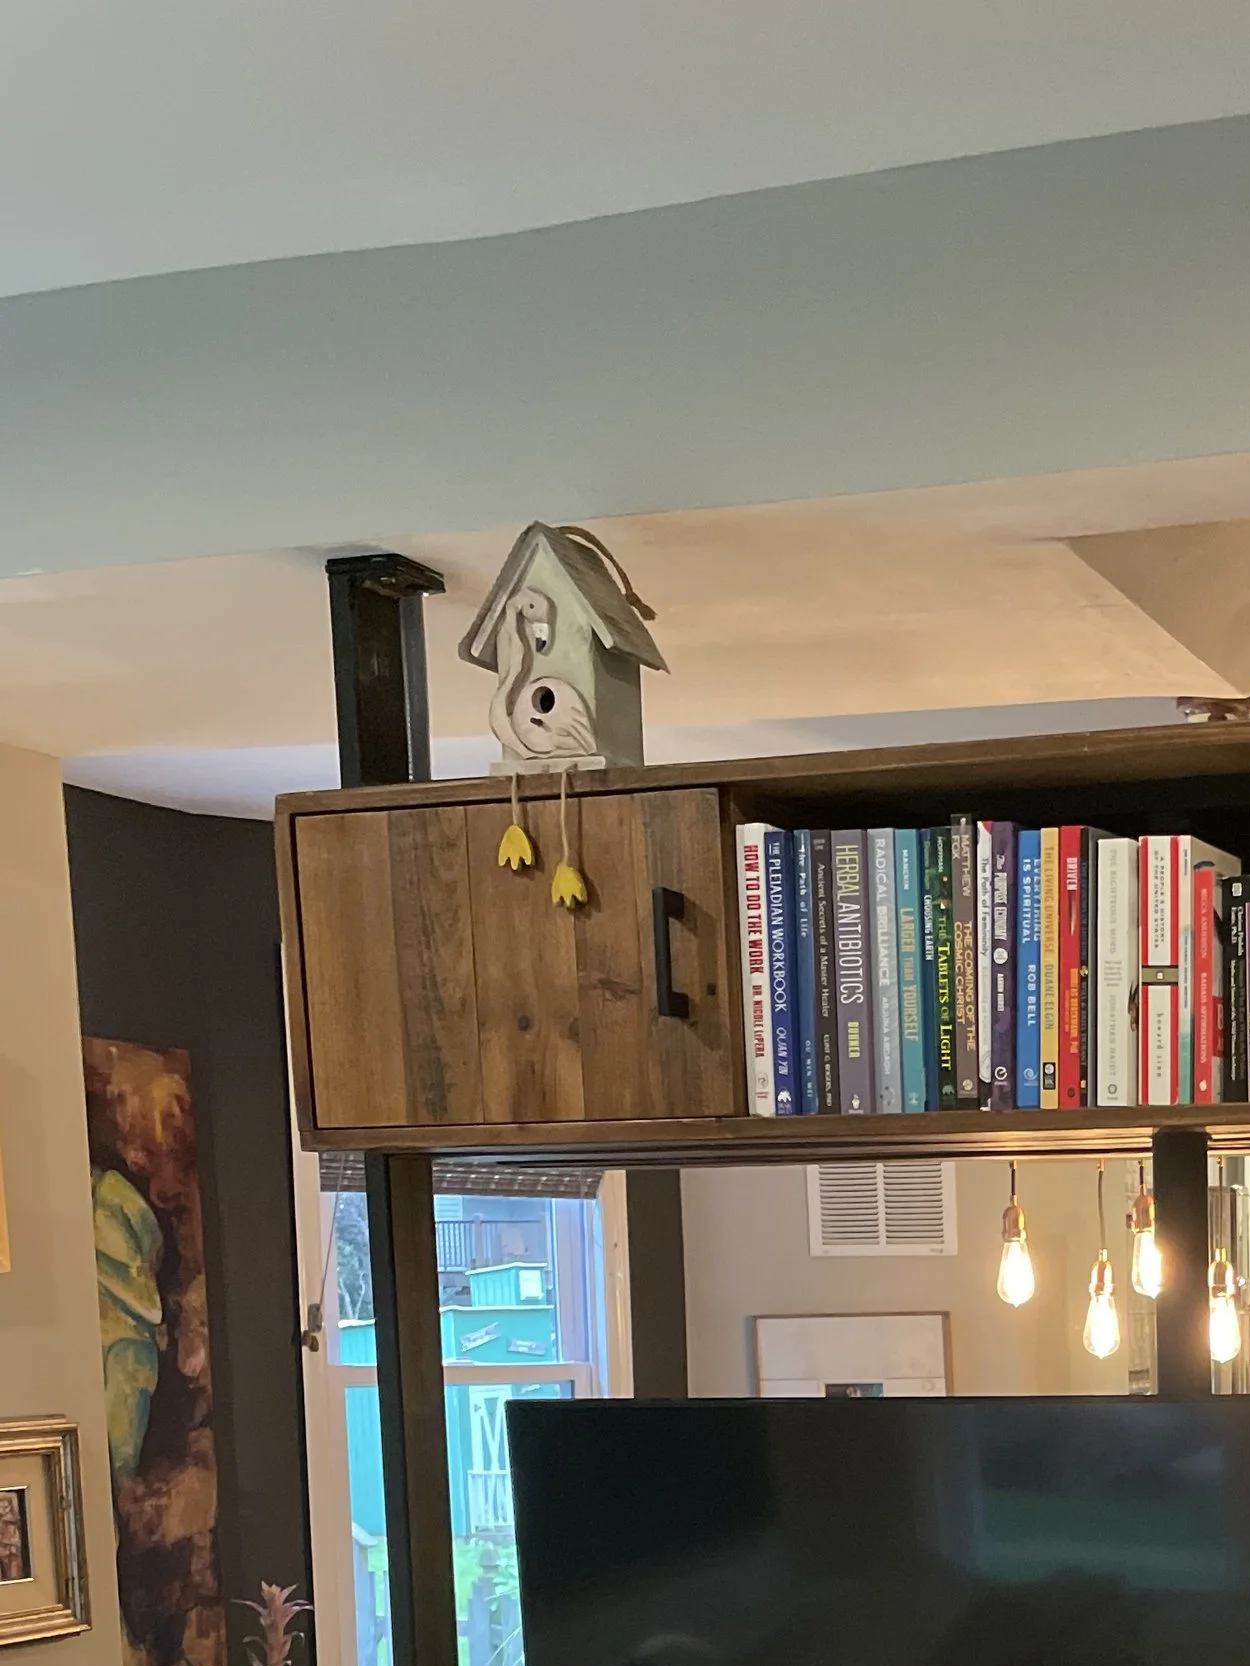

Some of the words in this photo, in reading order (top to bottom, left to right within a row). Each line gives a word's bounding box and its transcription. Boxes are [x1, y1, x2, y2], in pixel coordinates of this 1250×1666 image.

[744, 845, 760, 873] HOW
[769, 842, 781, 856] THE
[951, 835, 960, 859] FOX
[1044, 845, 1054, 865] THE
[1109, 848, 1117, 867] THE
[836, 845, 860, 900] HERBAL
[875, 839, 886, 901] RADICAL
[960, 834, 971, 897] MATTHEW
[980, 857, 989, 874] The
[1022, 858, 1031, 871] IS
[1066, 857, 1078, 890] DRIVEN
[745, 876, 761, 891] TO
[769, 859, 784, 925] PLEIADIAN
[799, 873, 807, 896] Path
[817, 863, 826, 898] Ancient
[981, 876, 989, 897] Path
[1044, 868, 1054, 903] LIVING
[746, 895, 761, 910] DO
[800, 901, 808, 912] of
[924, 895, 934, 934] CHOOSING
[981, 899, 989, 908] of
[1022, 876, 1031, 944] SPIRITUAL
[1033, 858, 1041, 941] EVERYTHING
[747, 914, 762, 935] THE
[800, 918, 809, 938] Life
[818, 900, 827, 933] Secrets
[900, 907, 915, 952] LARGER
[938, 915, 947, 940] THE
[1044, 906, 1055, 953] UNIVERSE
[820, 936, 828, 945] of
[878, 905, 889, 986] BRILLIANCE
[925, 935, 934, 961] EARTH
[953, 921, 964, 972] COSMIC
[963, 921, 973, 947] THE
[980, 911, 989, 957] Femininity
[748, 940, 764, 974] WORK
[837, 902, 864, 1004] ANTIBIOTICS
[904, 956, 914, 980] THAN
[771, 929, 788, 1012] WORKBOOK
[820, 956, 829, 986] Master
[938, 943, 951, 1003] TABLETS
[965, 951, 974, 1002] COMING
[1027, 964, 1036, 991] ROB
[1044, 964, 1054, 998] DUANE
[753, 1000, 764, 1028] NICOLE
[821, 989, 830, 1017] Healer
[903, 984, 917, 1042] YOURSELF
[940, 1006, 949, 1021] OF
[955, 975, 965, 1025] CHRIST
[965, 1005, 975, 1022] OF
[1027, 996, 1036, 1027] BELL
[1044, 1001, 1054, 1030] ELGIN
[776, 1026, 787, 1056] QUAN
[966, 1025, 976, 1051] THE
[1156, 1013, 1164, 1050] howard
[940, 1025, 953, 1070] LIGHT
